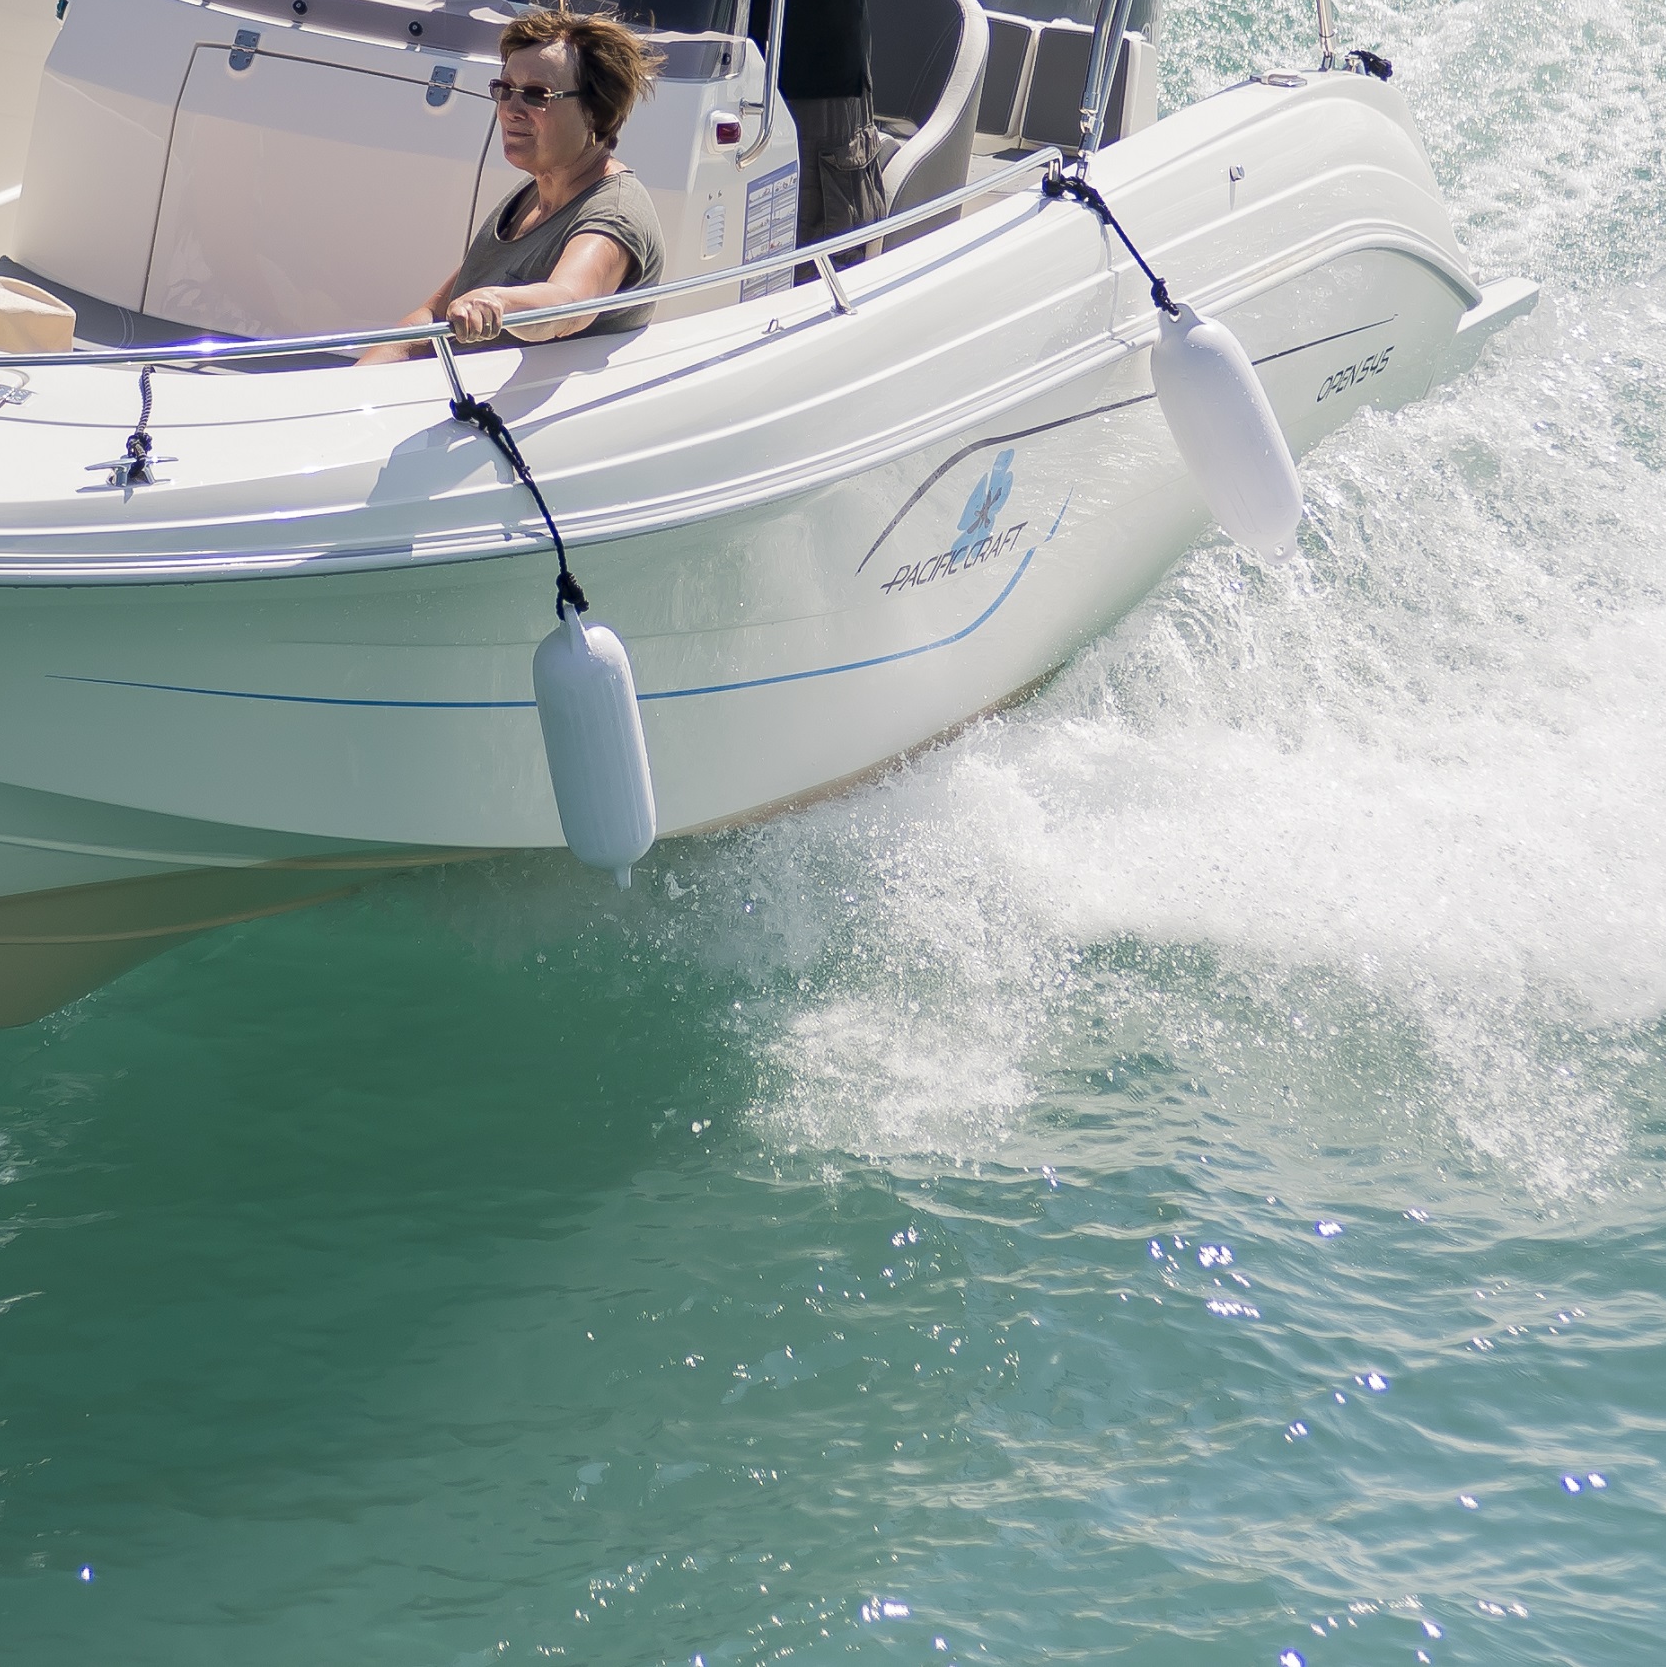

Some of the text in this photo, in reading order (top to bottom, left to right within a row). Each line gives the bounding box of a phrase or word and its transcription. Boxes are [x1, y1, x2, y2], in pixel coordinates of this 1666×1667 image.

[1317, 345, 1395, 402] OPEN 545
[880, 521, 1029, 594] PACIFIC CRAFT
